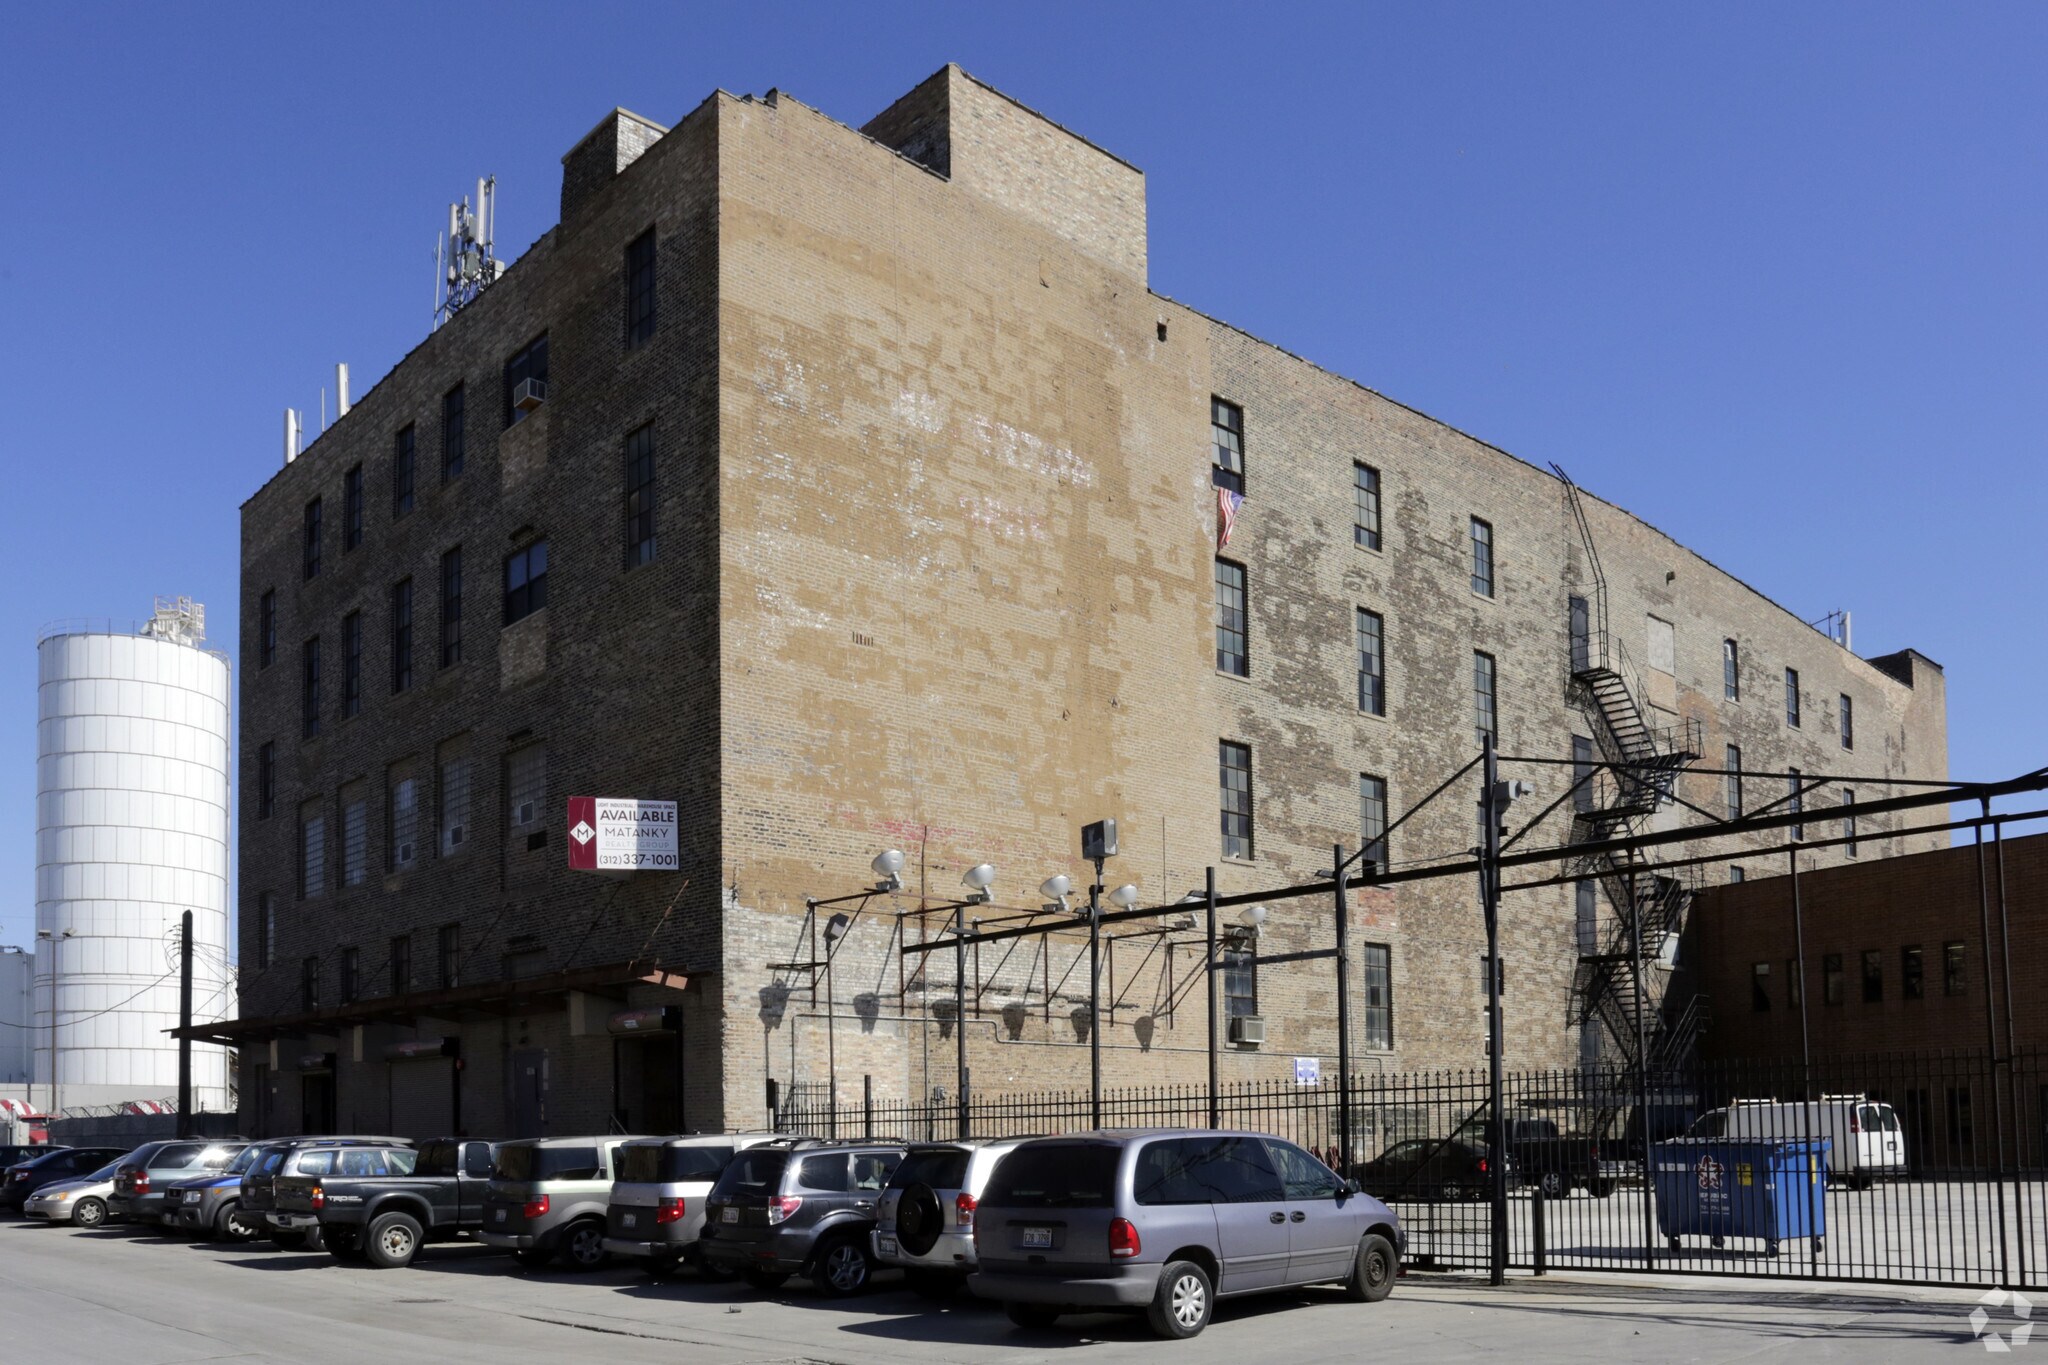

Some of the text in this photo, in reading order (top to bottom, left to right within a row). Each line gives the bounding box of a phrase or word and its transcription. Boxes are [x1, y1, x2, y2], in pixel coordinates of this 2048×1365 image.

[600, 810, 674, 822] AVAILABLE
[577, 828, 588, 838] M
[605, 827, 668, 838] MATANKY
[640, 841, 669, 849] GROUP
